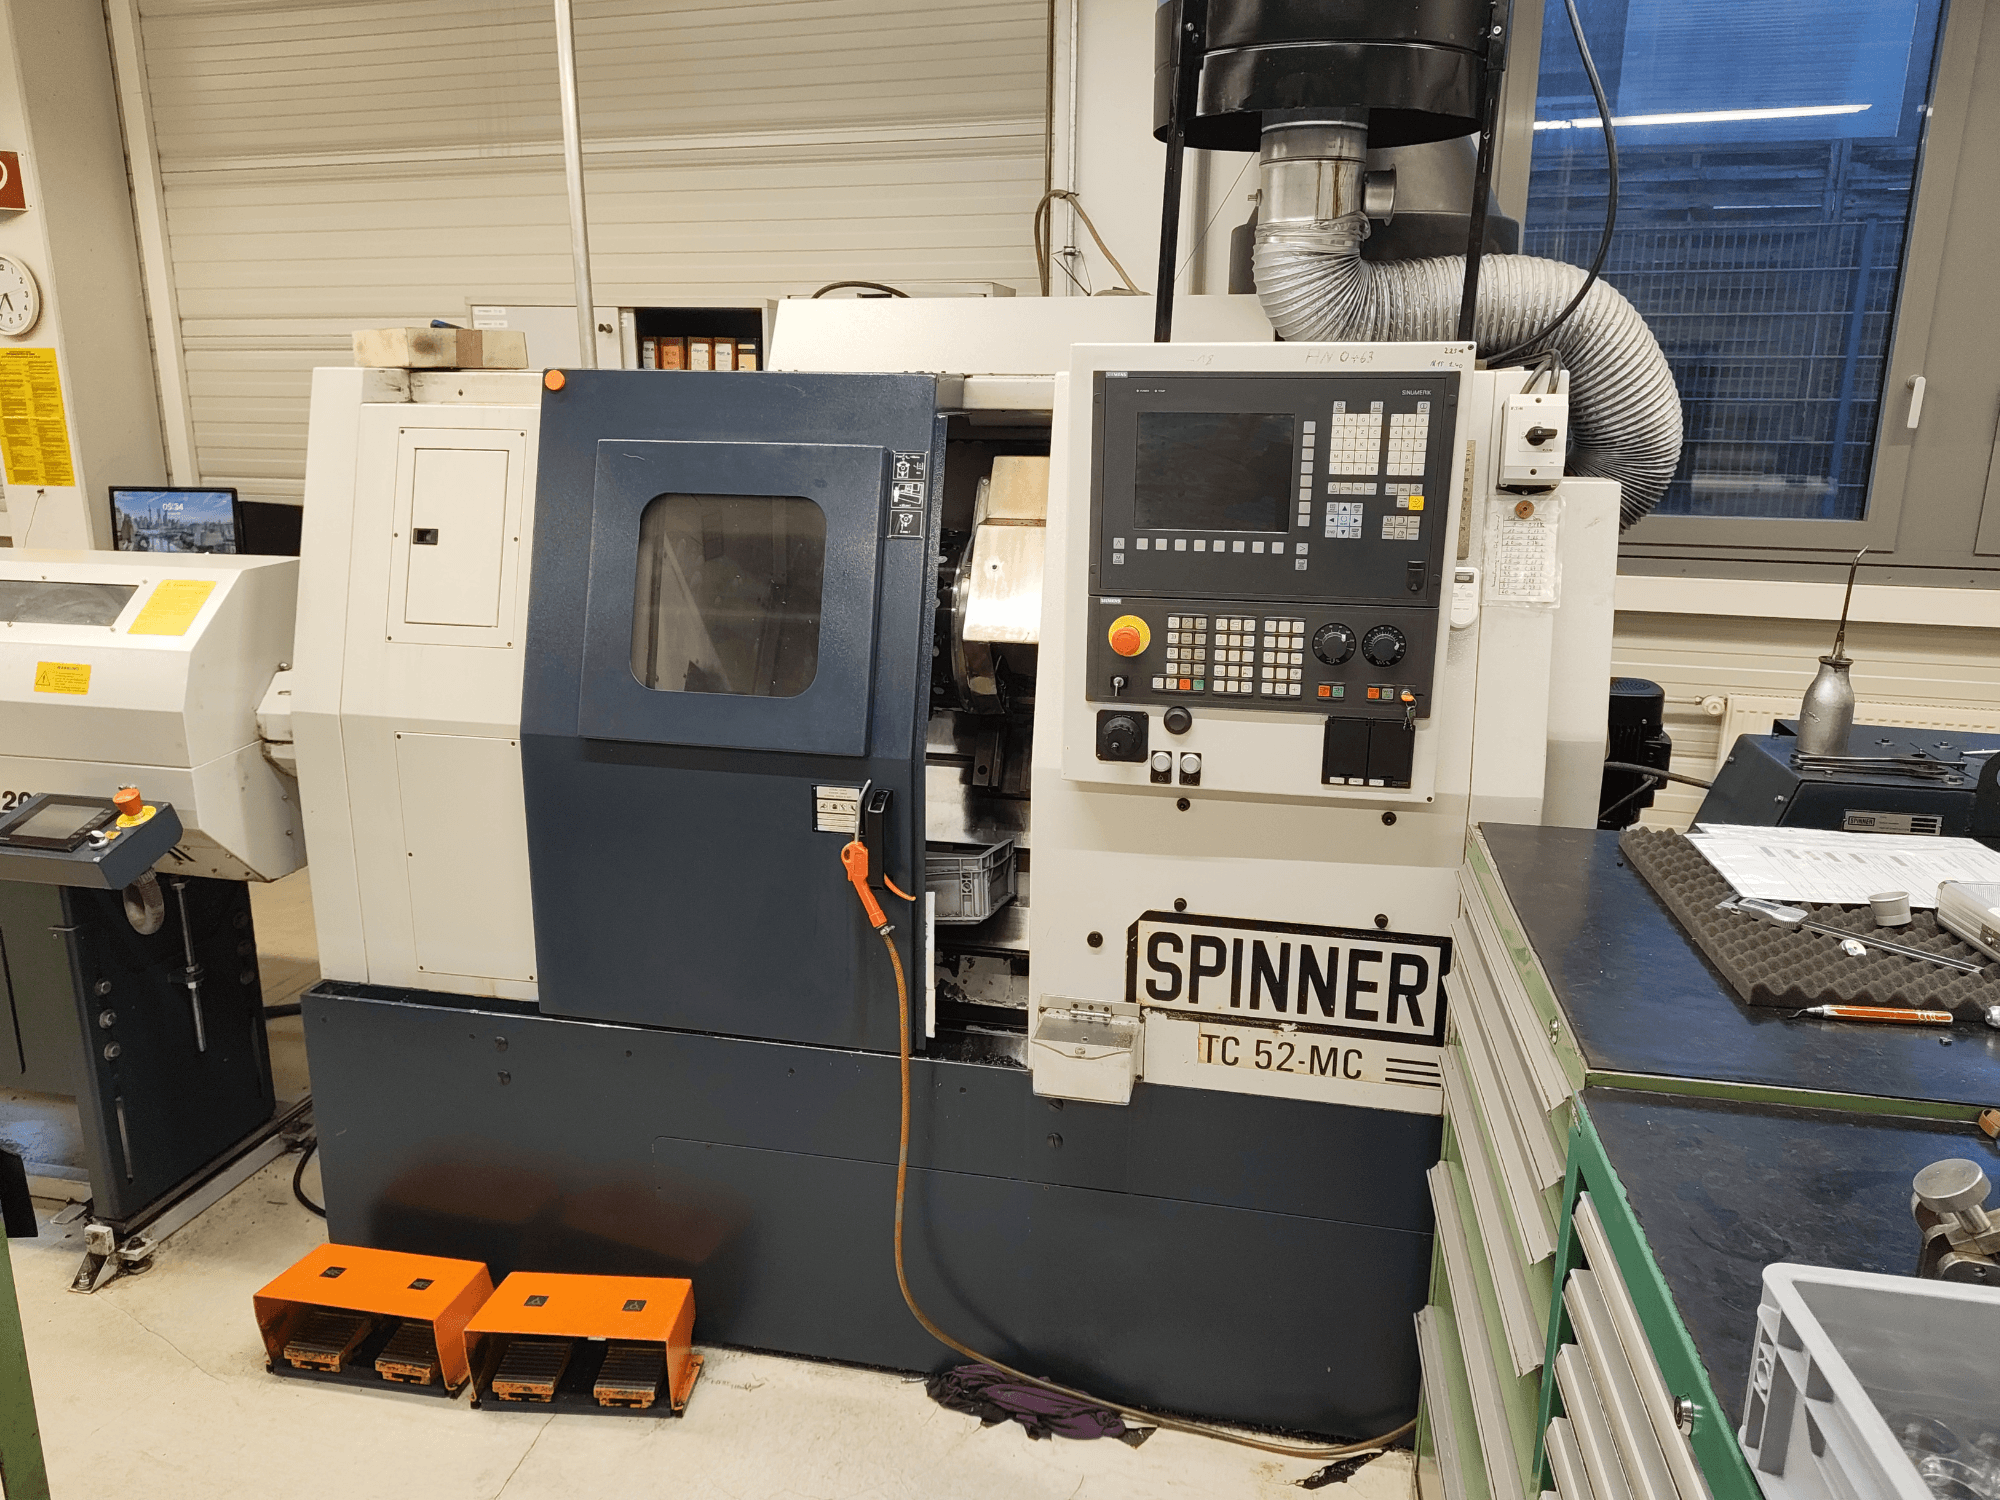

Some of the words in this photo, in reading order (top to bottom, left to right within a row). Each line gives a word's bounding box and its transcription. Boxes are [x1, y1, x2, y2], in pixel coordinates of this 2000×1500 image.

[1850, 817, 1873, 825] SPINNER
[1146, 932, 1428, 1027] SPINNER
[1201, 1034, 1240, 1066] TC
[1255, 1040, 1363, 1080] 52-MC
